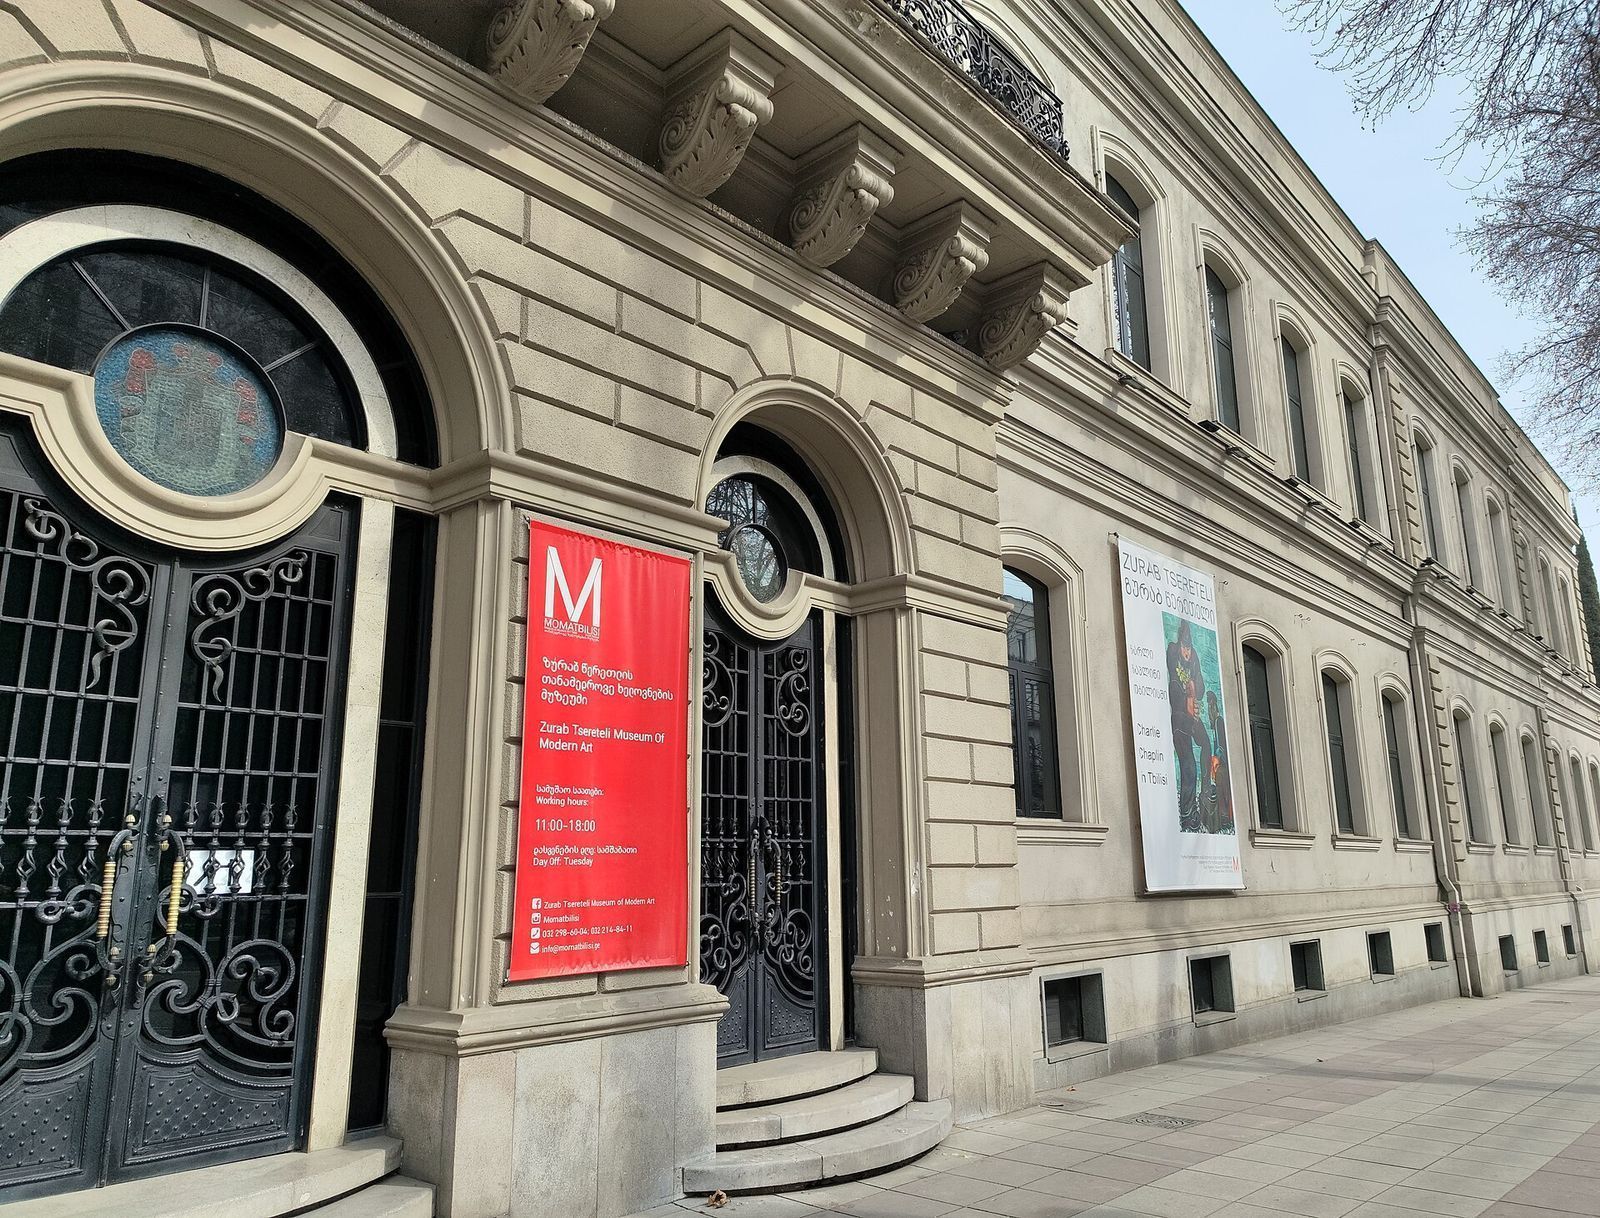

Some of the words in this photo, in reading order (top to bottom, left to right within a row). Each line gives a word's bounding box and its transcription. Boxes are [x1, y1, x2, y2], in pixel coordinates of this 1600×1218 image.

[1122, 552, 1161, 580] ZURAB
[1163, 568, 1213, 602] TSERETELI
[545, 545, 602, 627] M
[544, 618, 600, 637] MOMATBILISI
[542, 656, 579, 672] ზურაბ
[581, 663, 634, 680] წერეთლის
[541, 674, 615, 695] თანამედროვე
[617, 683, 674, 701] ხელოვნების
[540, 688, 588, 706] მუზეუმი
[539, 721, 569, 735] Zurab
[572, 724, 610, 739] Tsereteli
[613, 729, 653, 742] Museum
[654, 733, 665, 743] Of
[539, 737, 578, 751] Modern
[580, 741, 593, 753] Art
[536, 796, 566, 808] Working
[567, 797, 589, 806] hours:
[535, 819, 596, 832] 11:00-18:00
[533, 857, 548, 868] Day
[549, 857, 562, 866] Off:
[563, 857, 594, 867] Tuesday
[543, 901, 562, 909] Zurab
[563, 899, 590, 909] Tsereteli
[591, 899, 616, 908] Museum
[617, 898, 624, 906] of
[624, 898, 646, 906] Modern
[646, 897, 655, 905] Art
[543, 914, 580, 924] Momatbilisi
[542, 929, 554, 938] 032
[590, 926, 601, 935] 032
[601, 925, 633, 935] 214-84-11
[541, 942, 601, 955] info@momatbilisi.ge
